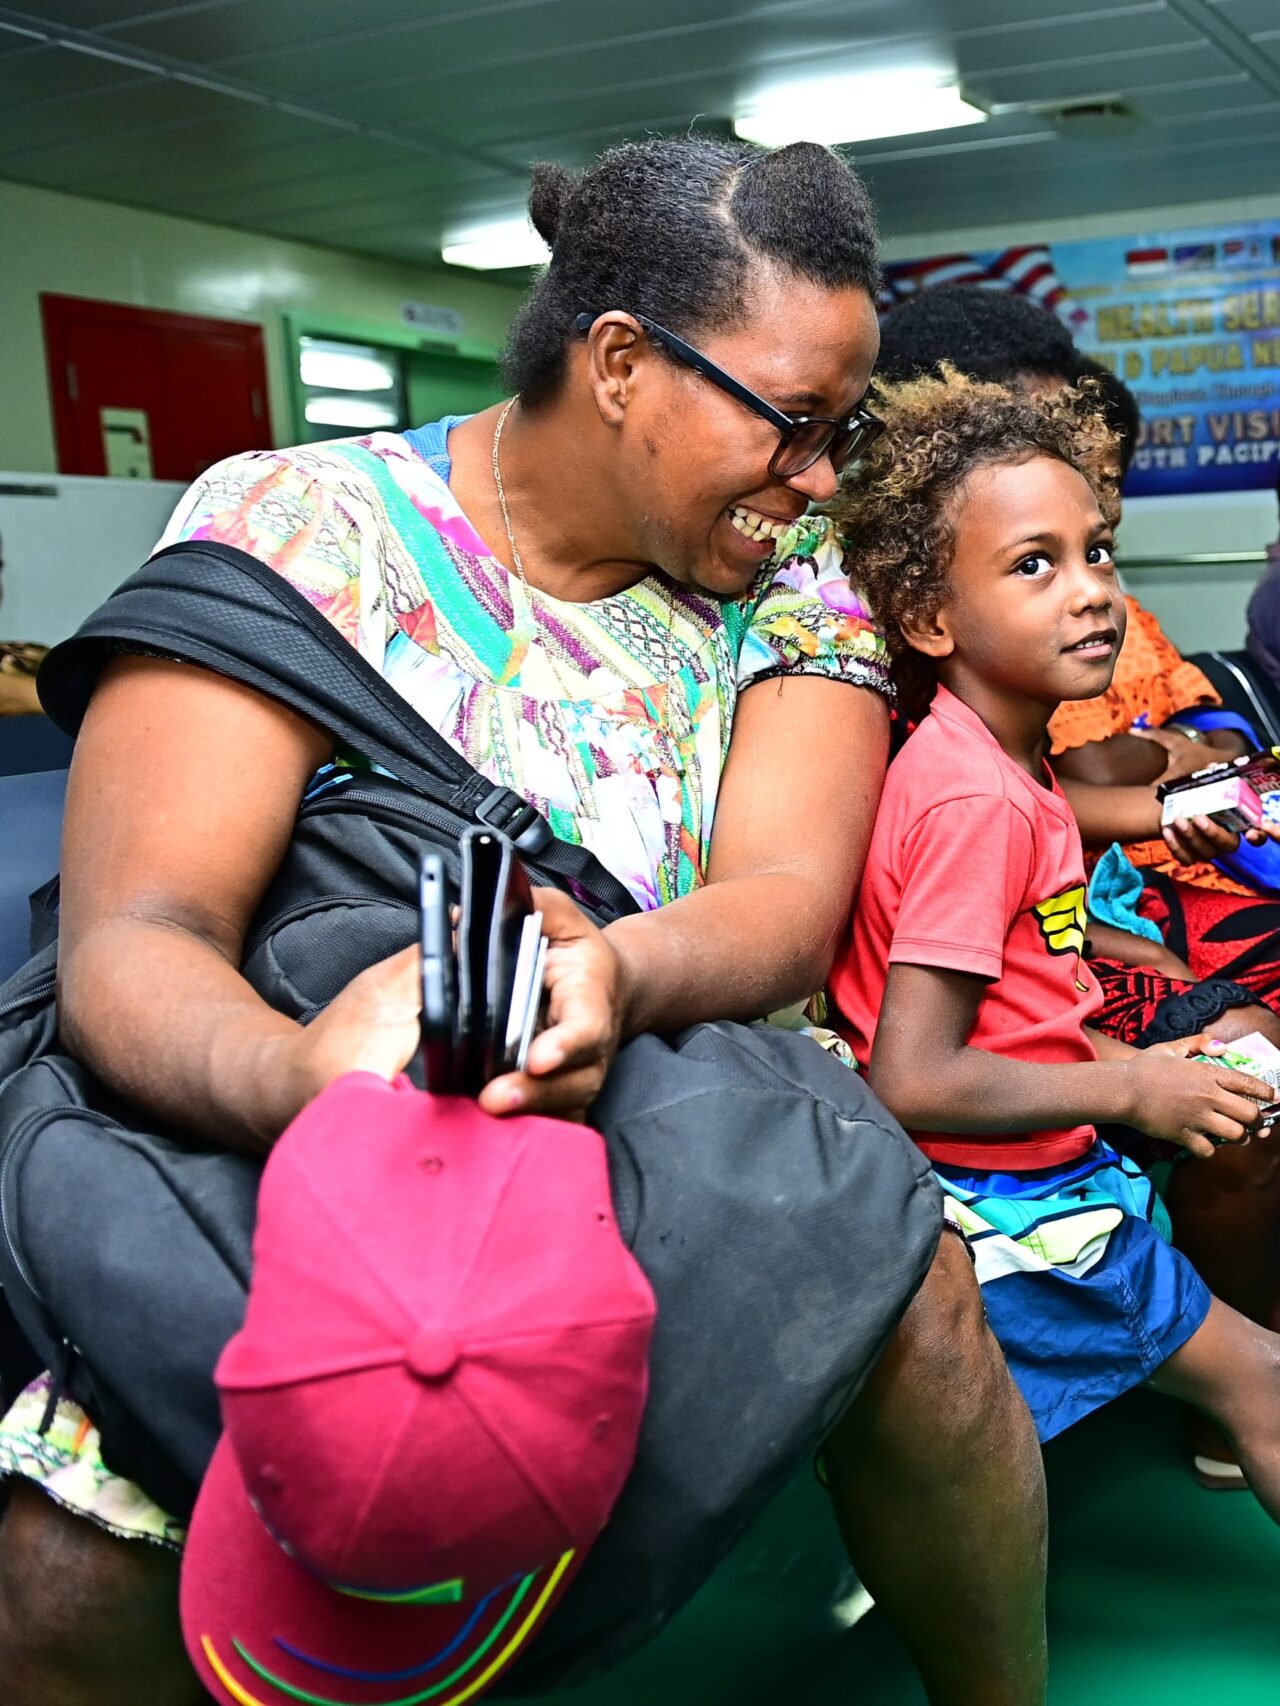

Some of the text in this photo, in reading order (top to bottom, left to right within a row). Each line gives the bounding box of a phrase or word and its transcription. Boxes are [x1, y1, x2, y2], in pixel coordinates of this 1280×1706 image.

[1096, 298, 1214, 342] HEALTH
[1151, 340, 1244, 377] PAPUA
[1135, 415, 1197, 447] ORT
